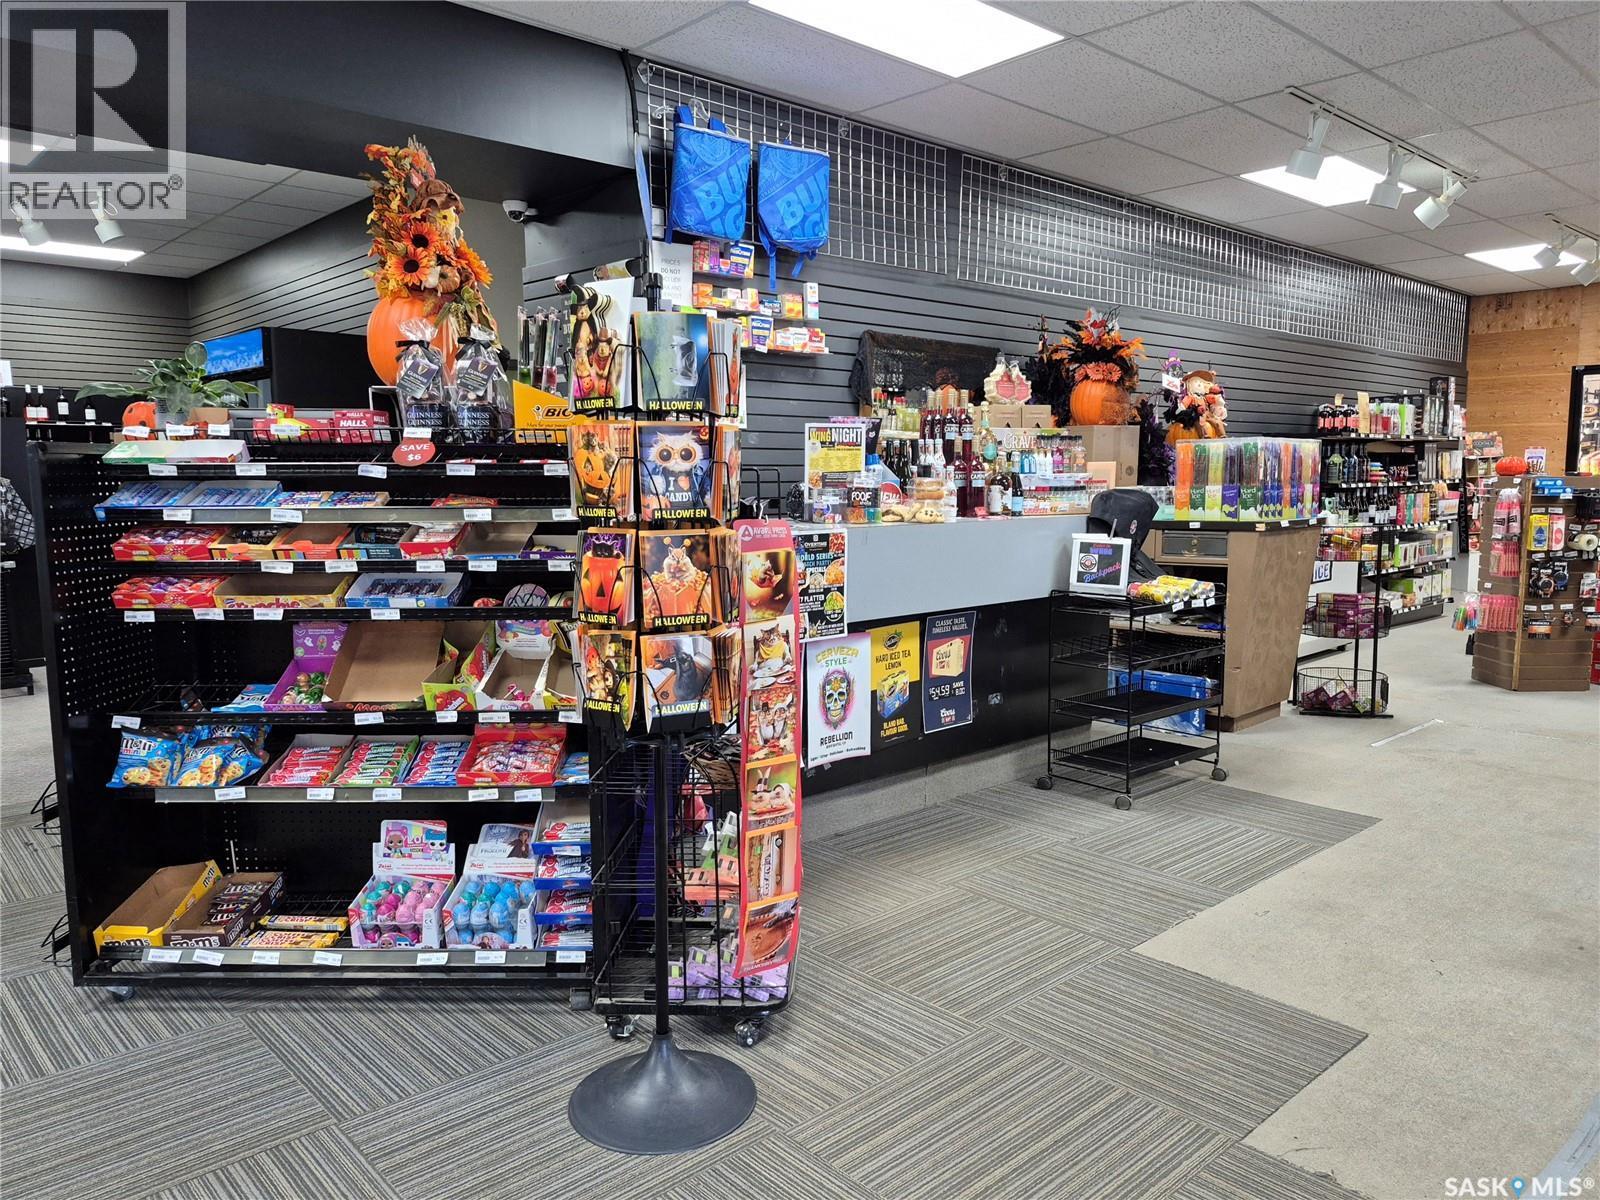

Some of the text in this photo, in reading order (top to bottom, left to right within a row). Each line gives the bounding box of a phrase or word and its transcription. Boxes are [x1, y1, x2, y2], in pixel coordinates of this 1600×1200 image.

[649, 401, 703, 410] HALLOWEN
[810, 428, 862, 443] WING NIGHT
[401, 443, 430, 453] SAVE
[407, 453, 422, 461] $6
[816, 552, 834, 560] SERIES
[1083, 561, 1121, 583] Backpack
[1315, 564, 1329, 580] ICE
[935, 619, 953, 627] CLASSIC
[932, 625, 952, 634] TIMELESS
[816, 646, 860, 663] CERVEZA
[876, 649, 911, 664] HARD ICED TEA
[825, 657, 848, 667] STYLE
[885, 661, 902, 670] LEMON
[953, 680, 964, 689] SAVE
[820, 731, 853, 747] REBELLION
